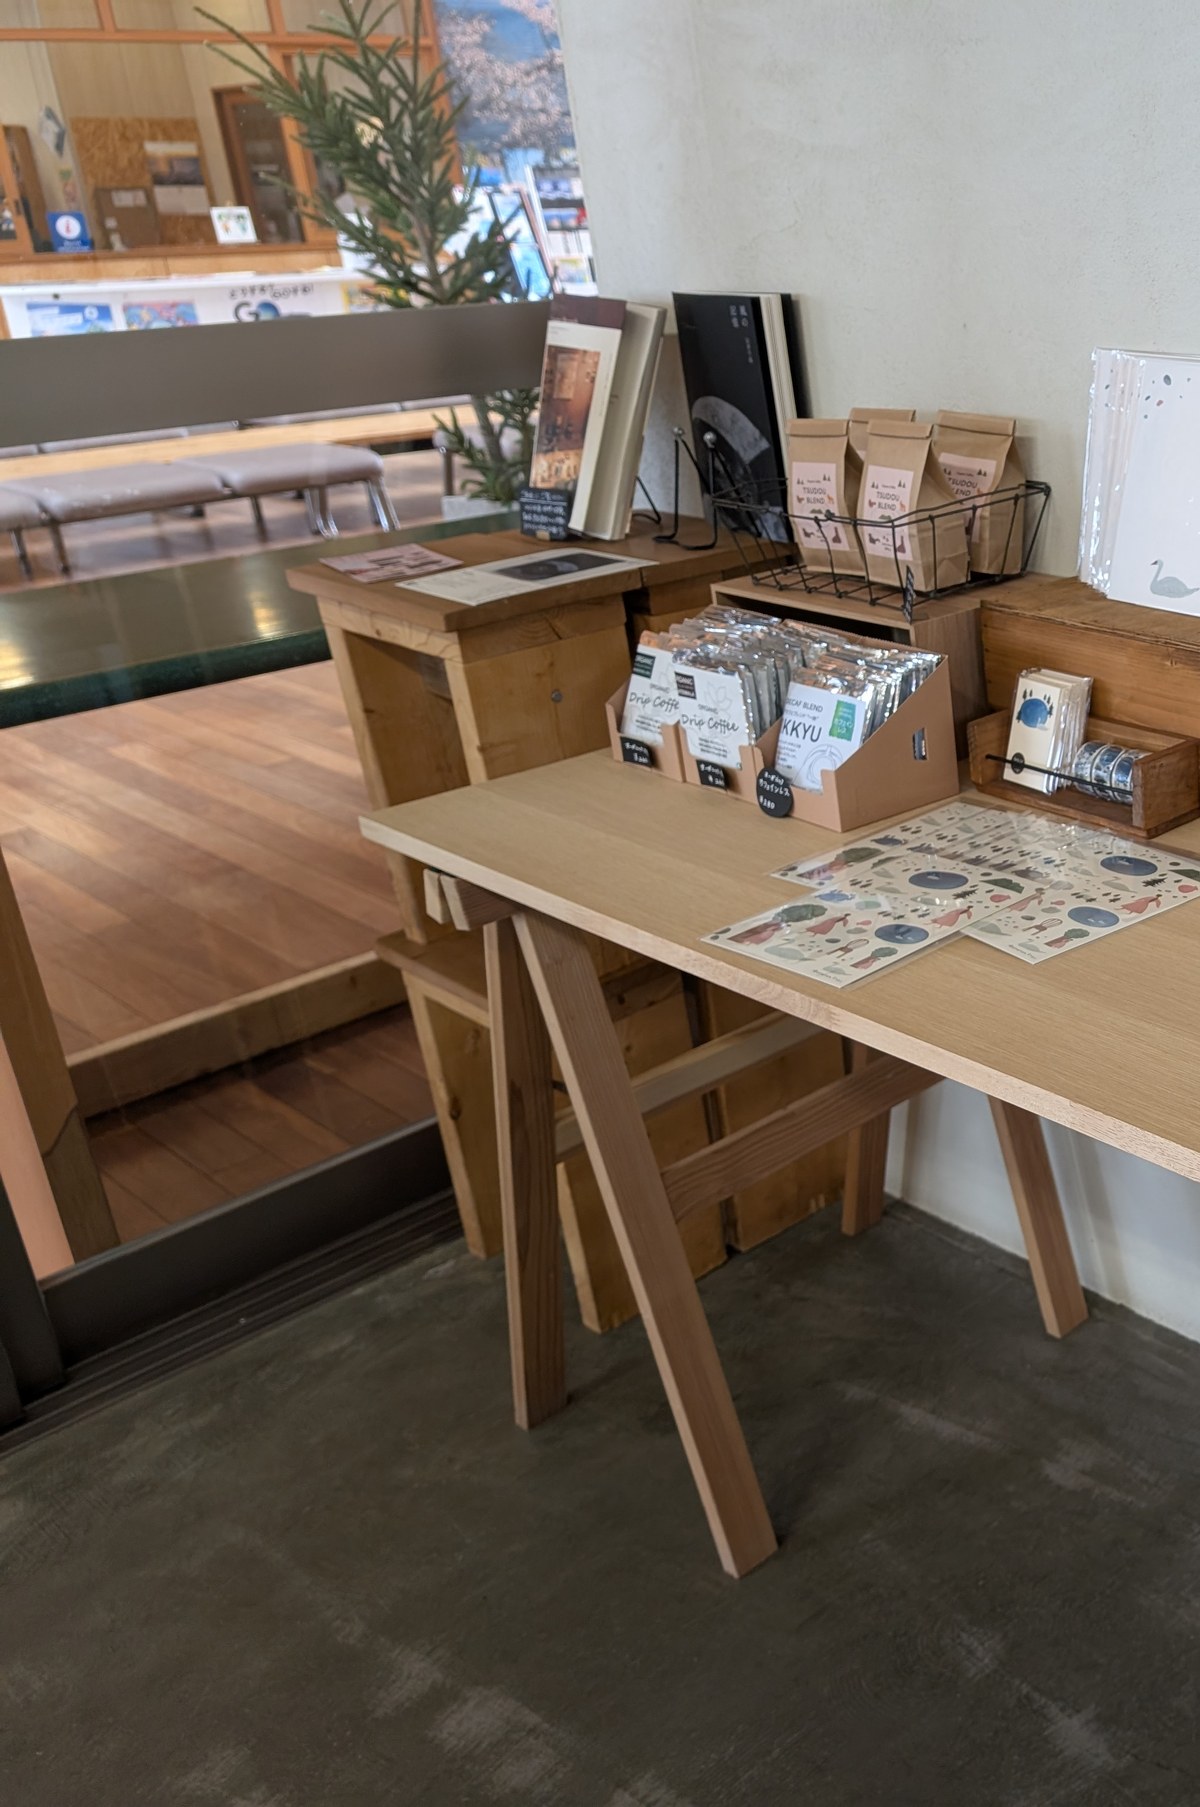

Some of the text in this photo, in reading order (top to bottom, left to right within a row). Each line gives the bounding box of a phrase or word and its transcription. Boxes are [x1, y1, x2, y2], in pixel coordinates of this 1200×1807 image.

[876, 491, 900, 502] TSUDOU
[877, 502, 897, 512] BLEND
[629, 692, 651, 708] Drip
[681, 714, 706, 730] Drip
[708, 717, 739, 734] Coffee
